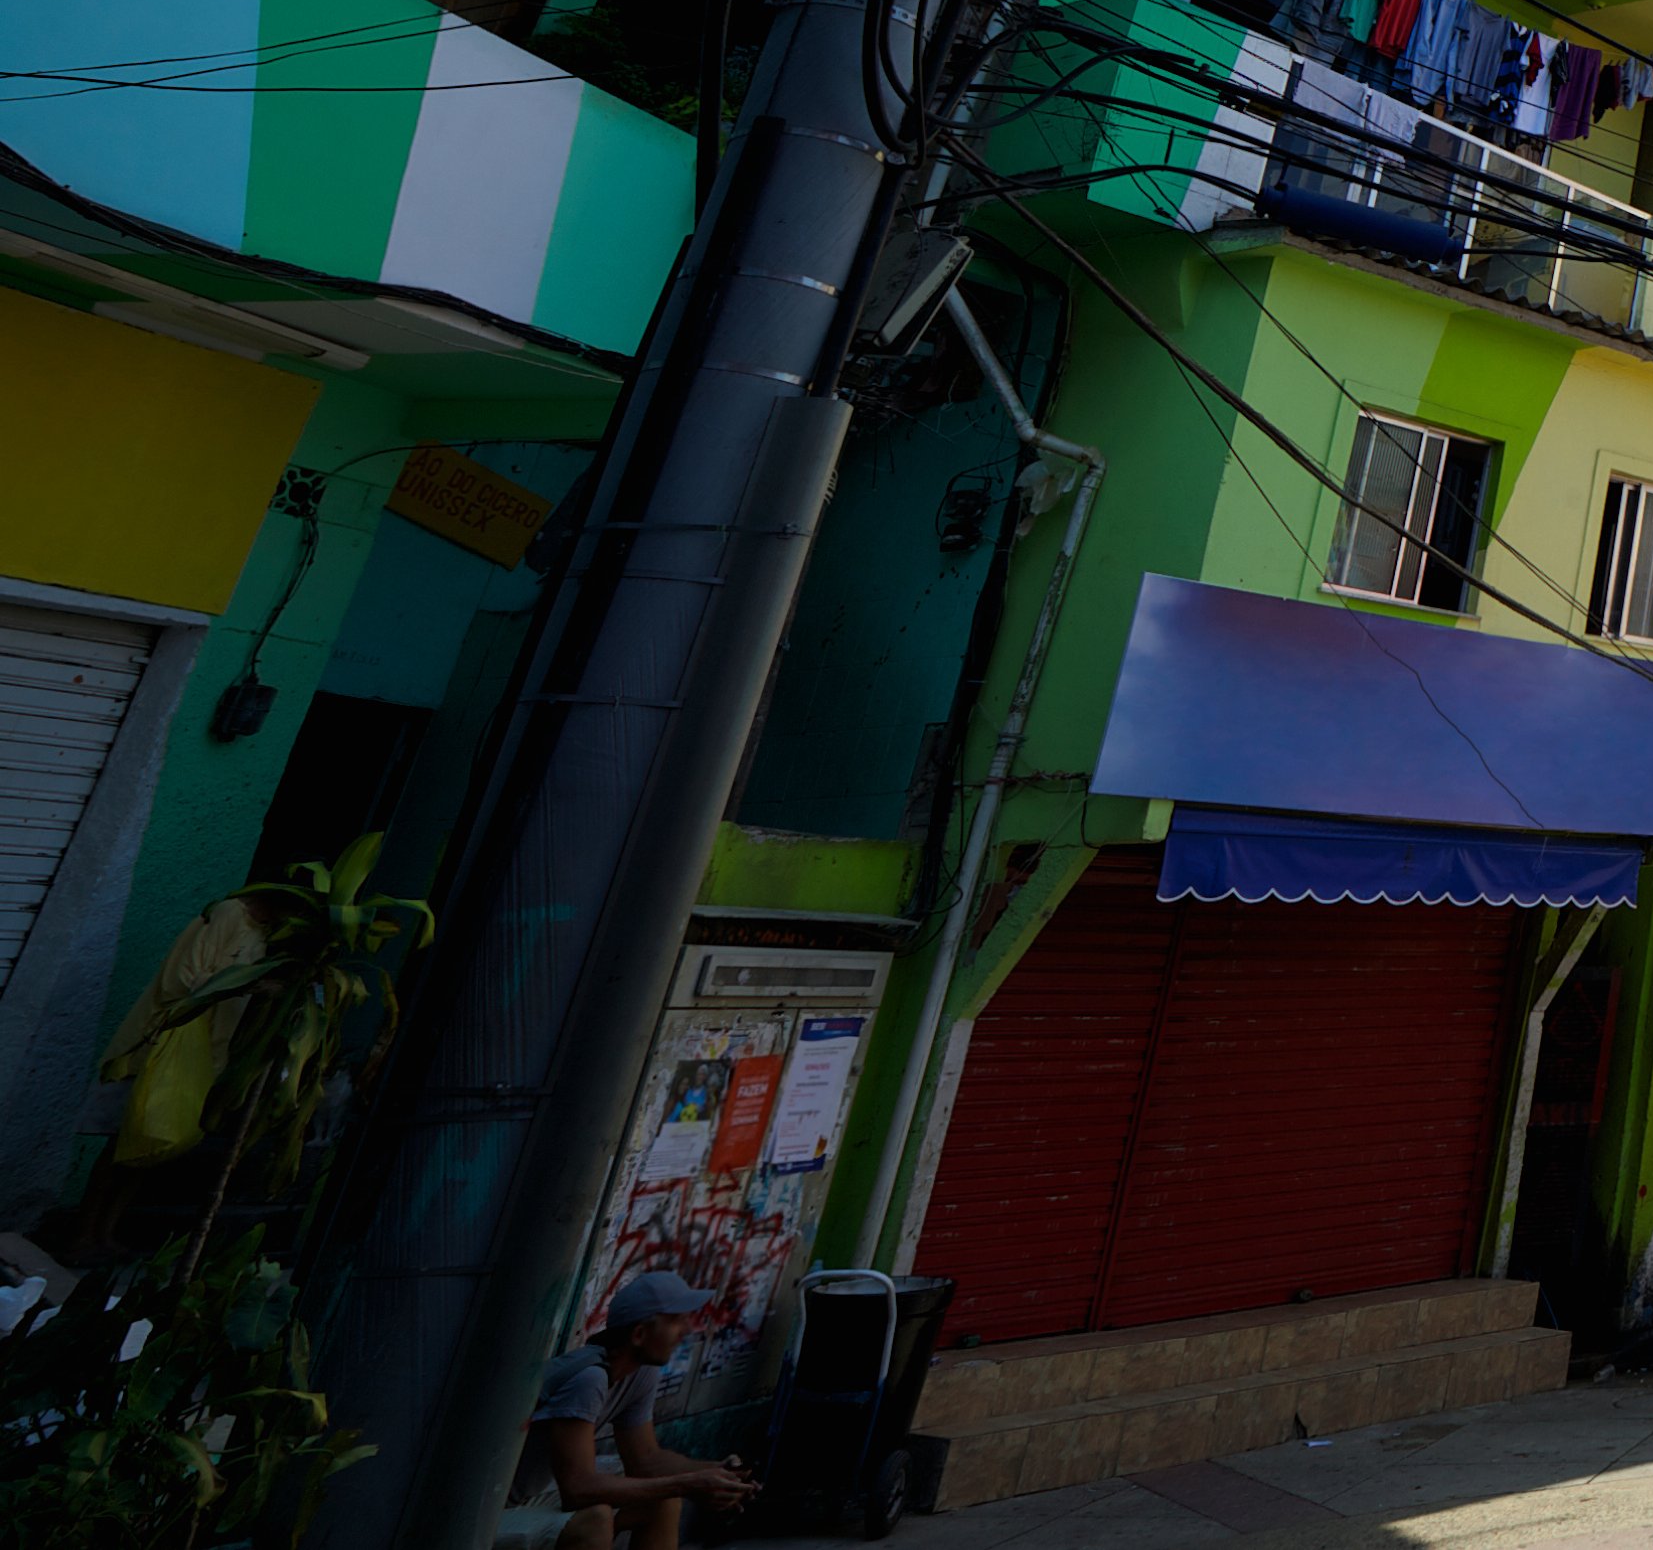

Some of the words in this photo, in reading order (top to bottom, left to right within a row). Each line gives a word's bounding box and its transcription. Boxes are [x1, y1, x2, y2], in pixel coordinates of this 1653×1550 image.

[397, 470, 497, 532] UNISSEX
[447, 467, 478, 494] DO
[476, 483, 541, 529] CICERO
